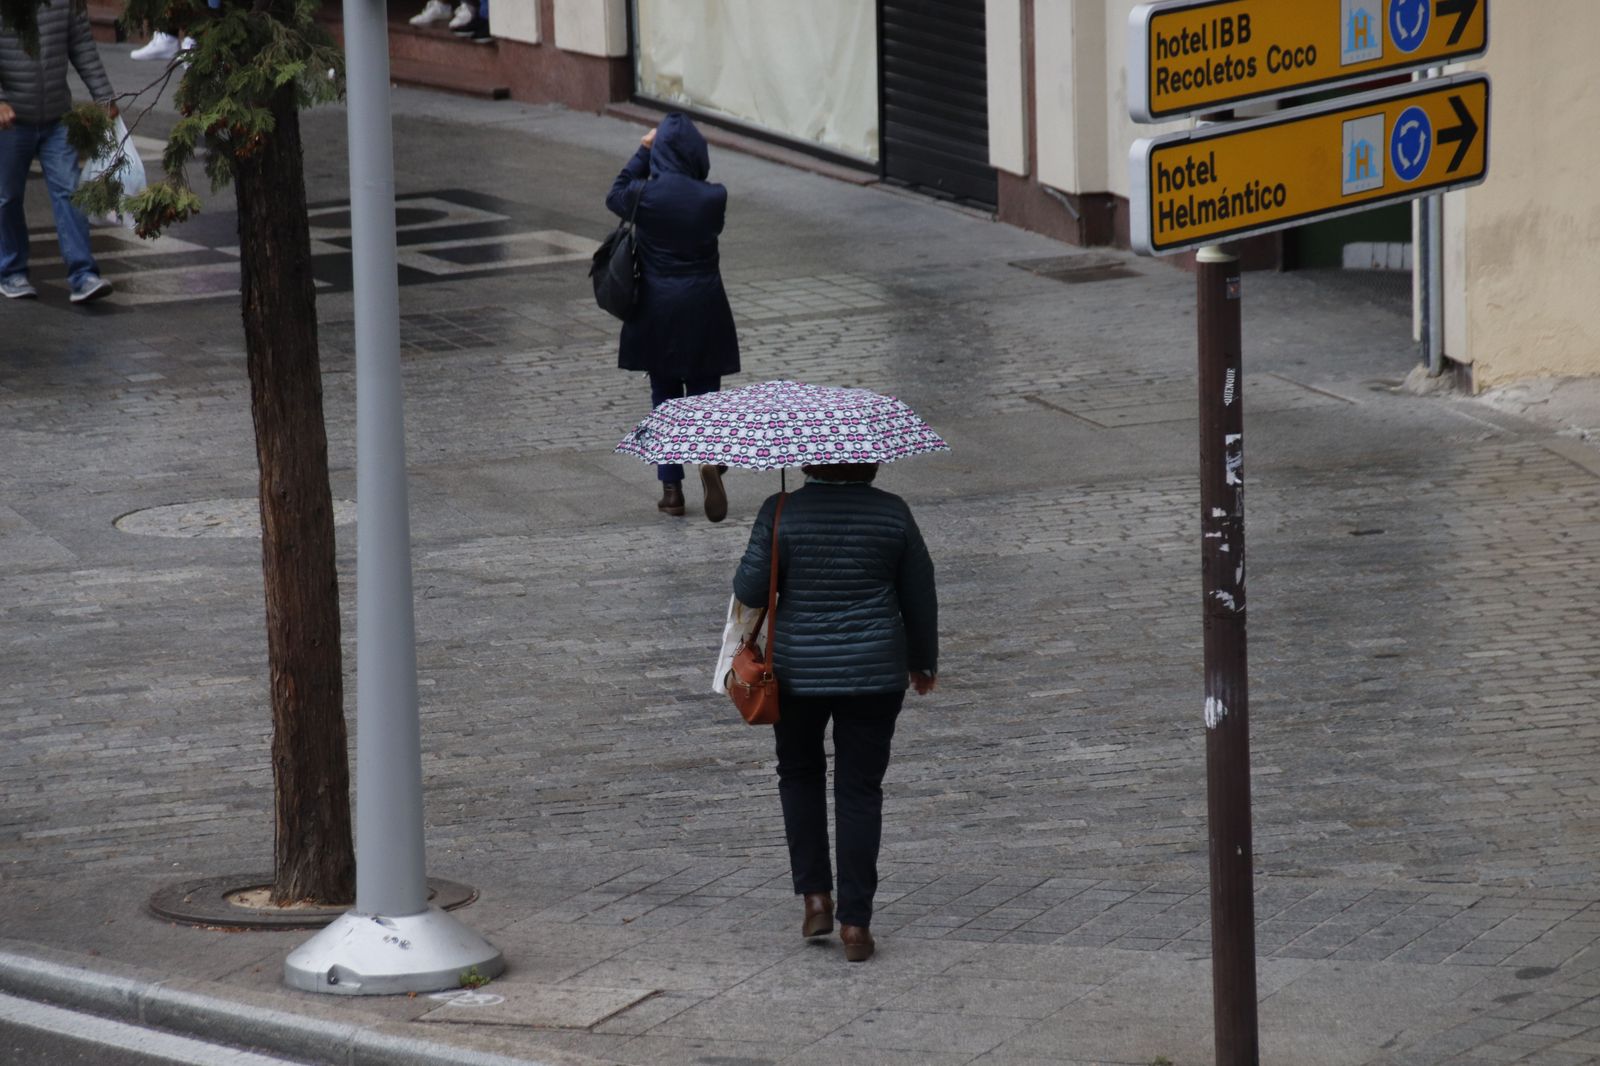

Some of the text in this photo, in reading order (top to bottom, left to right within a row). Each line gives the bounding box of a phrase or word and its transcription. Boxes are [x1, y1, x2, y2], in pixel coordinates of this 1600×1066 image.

[1156, 13, 1252, 61] hotel IBB
[1156, 44, 1317, 96] Recoletos Coco
[1157, 151, 1217, 194] hotel
[1158, 180, 1286, 233] Helmántico
